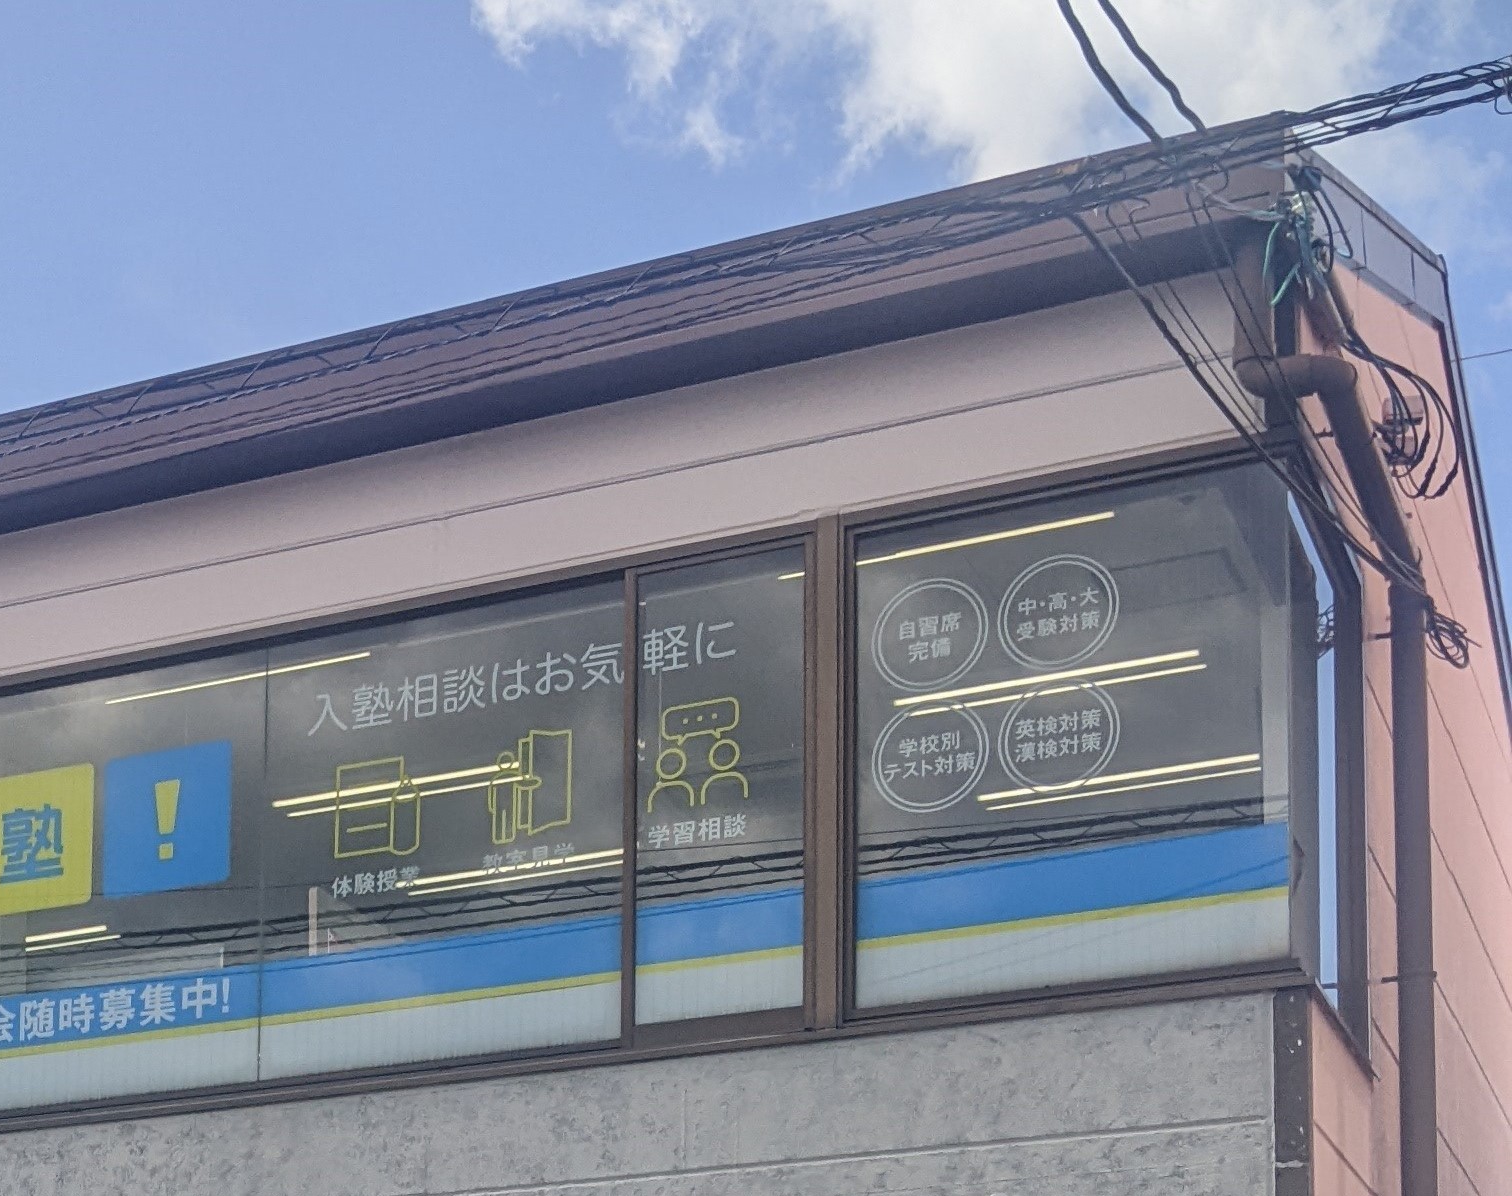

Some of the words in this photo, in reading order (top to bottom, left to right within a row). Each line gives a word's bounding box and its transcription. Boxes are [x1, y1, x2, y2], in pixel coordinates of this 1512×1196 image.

[898, 611, 962, 641] 自習席
[1016, 611, 1100, 642] 受験対策
[906, 639, 952, 664] 完備
[1015, 708, 1102, 739] 英検対策
[898, 730, 961, 757] 学校別
[1014, 732, 1102, 763] 漢検対策
[884, 752, 976, 782] テスト対策
[647, 812, 747, 849] 学習相談
[331, 865, 421, 900] 体験授業
